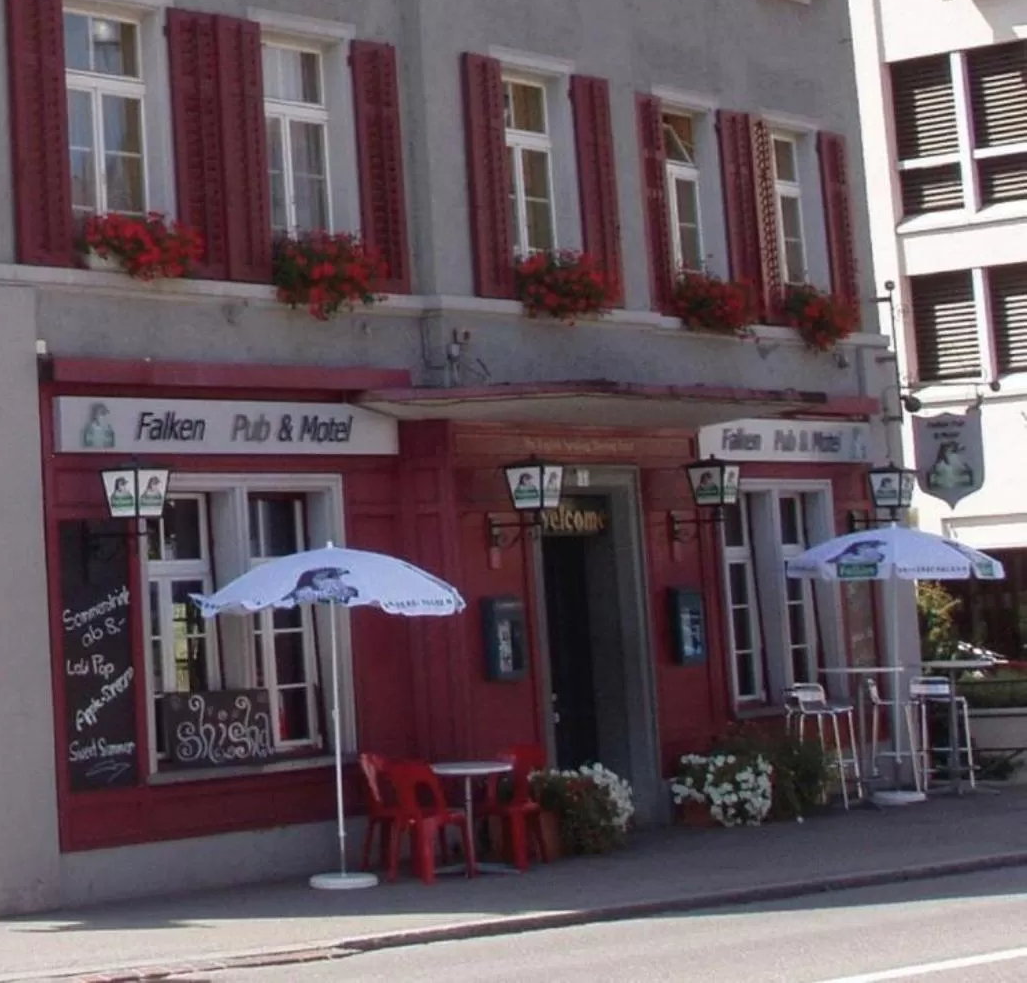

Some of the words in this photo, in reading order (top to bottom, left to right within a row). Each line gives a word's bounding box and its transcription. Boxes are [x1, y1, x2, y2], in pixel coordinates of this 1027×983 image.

[134, 411, 206, 442] Falken
[231, 414, 271, 442] Pub
[276, 414, 293, 442] &
[298, 414, 354, 443] Motel
